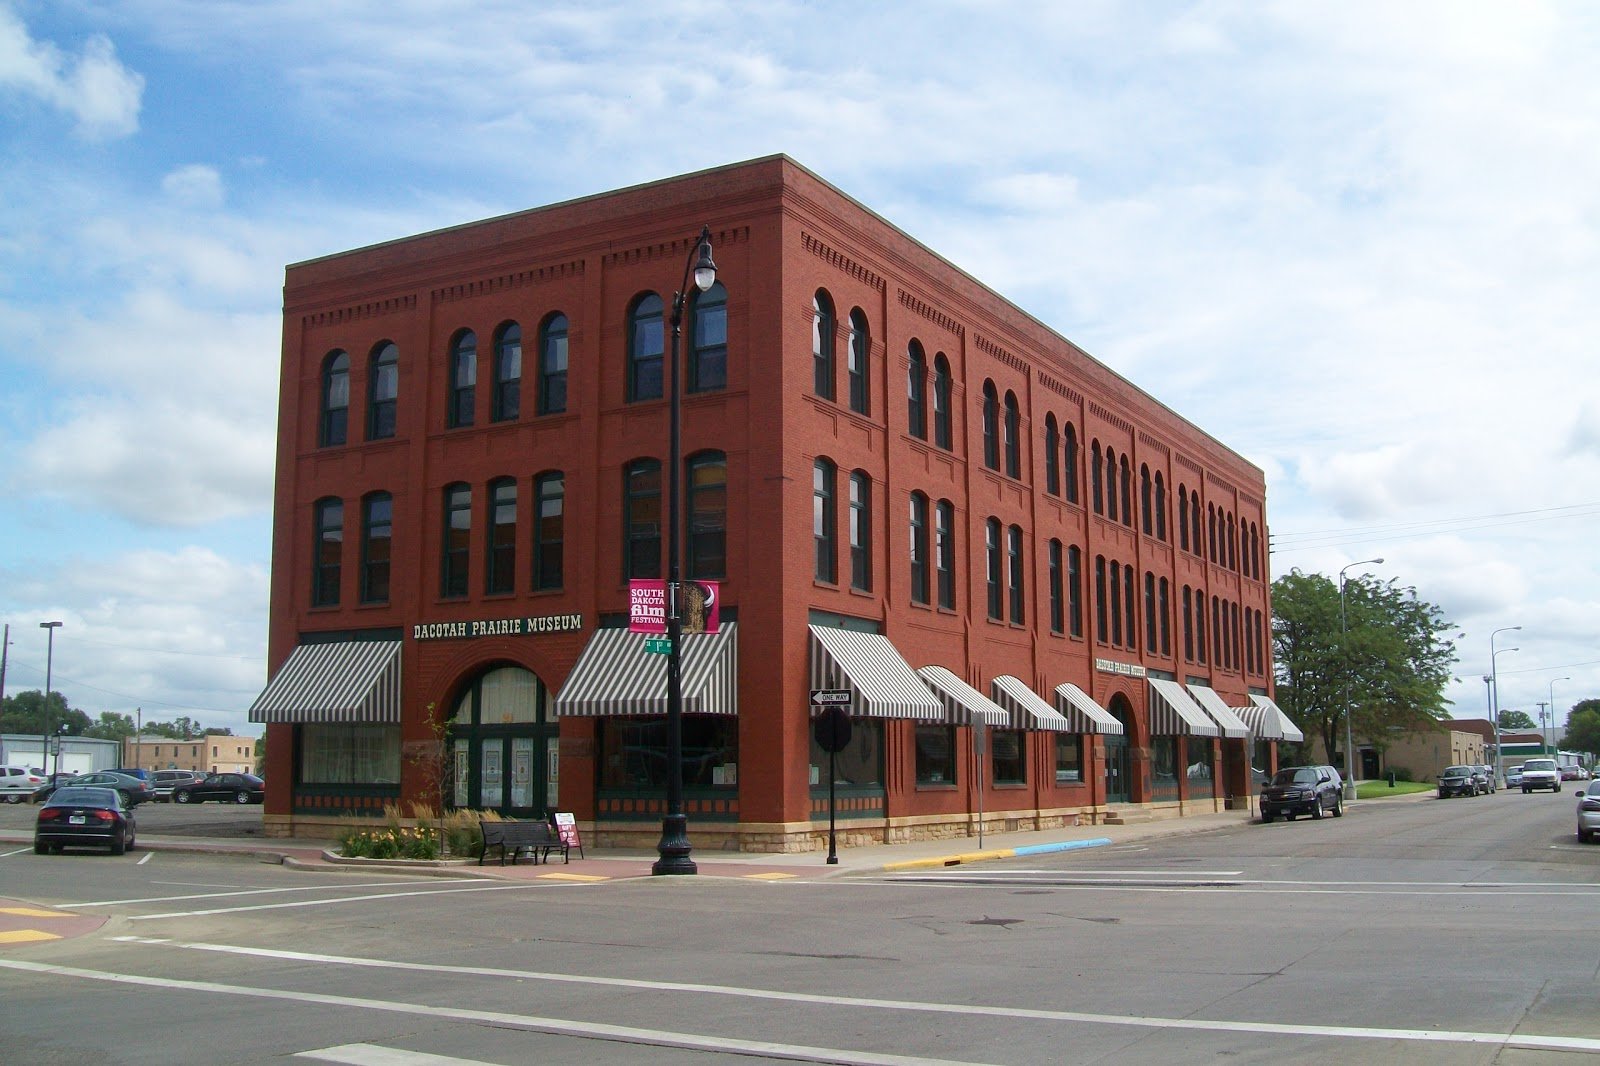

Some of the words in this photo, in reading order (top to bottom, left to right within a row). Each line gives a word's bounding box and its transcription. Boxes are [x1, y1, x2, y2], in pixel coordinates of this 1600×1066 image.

[631, 589, 665, 597] SOUTH
[631, 597, 665, 605] DAKOTA
[630, 604, 665, 617] film
[631, 616, 665, 624] FESTIVAL
[414, 622, 467, 639] DACOTAH
[472, 619, 521, 636] PRAIRIE
[527, 614, 582, 633] MUSEUM
